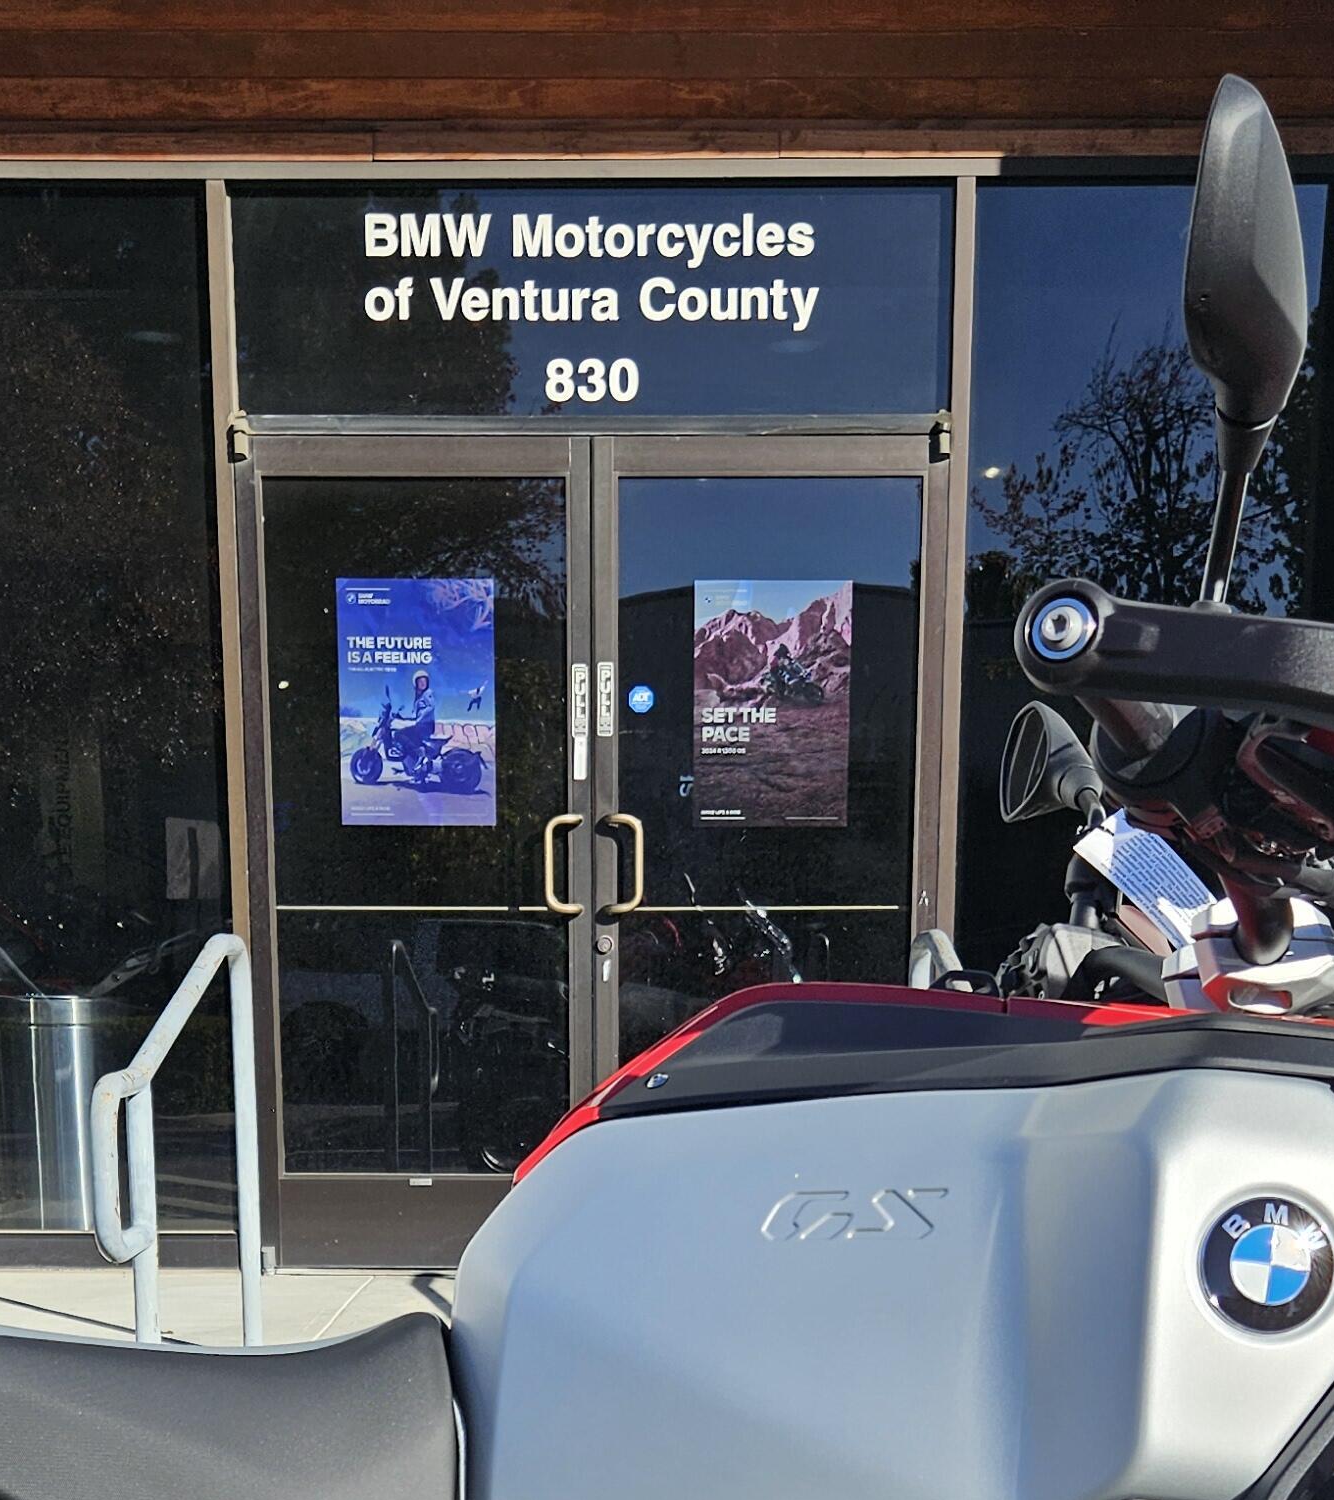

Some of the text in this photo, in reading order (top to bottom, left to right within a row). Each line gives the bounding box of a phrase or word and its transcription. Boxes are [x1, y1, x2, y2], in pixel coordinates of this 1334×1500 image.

[364, 213, 815, 269] BMW Motorcycles
[364, 277, 819, 331] of Ventura County
[544, 358, 640, 402] 830
[347, 637, 432, 649] THE FUTURE
[347, 652, 433, 664] IS A FEELING
[575, 671, 585, 719] PULL
[600, 669, 611, 717] PULL
[701, 707, 777, 723] SET THE
[701, 726, 751, 742] PACE
[761, 1187, 948, 1241] GS
[1221, 1202, 1328, 1252] BMW
